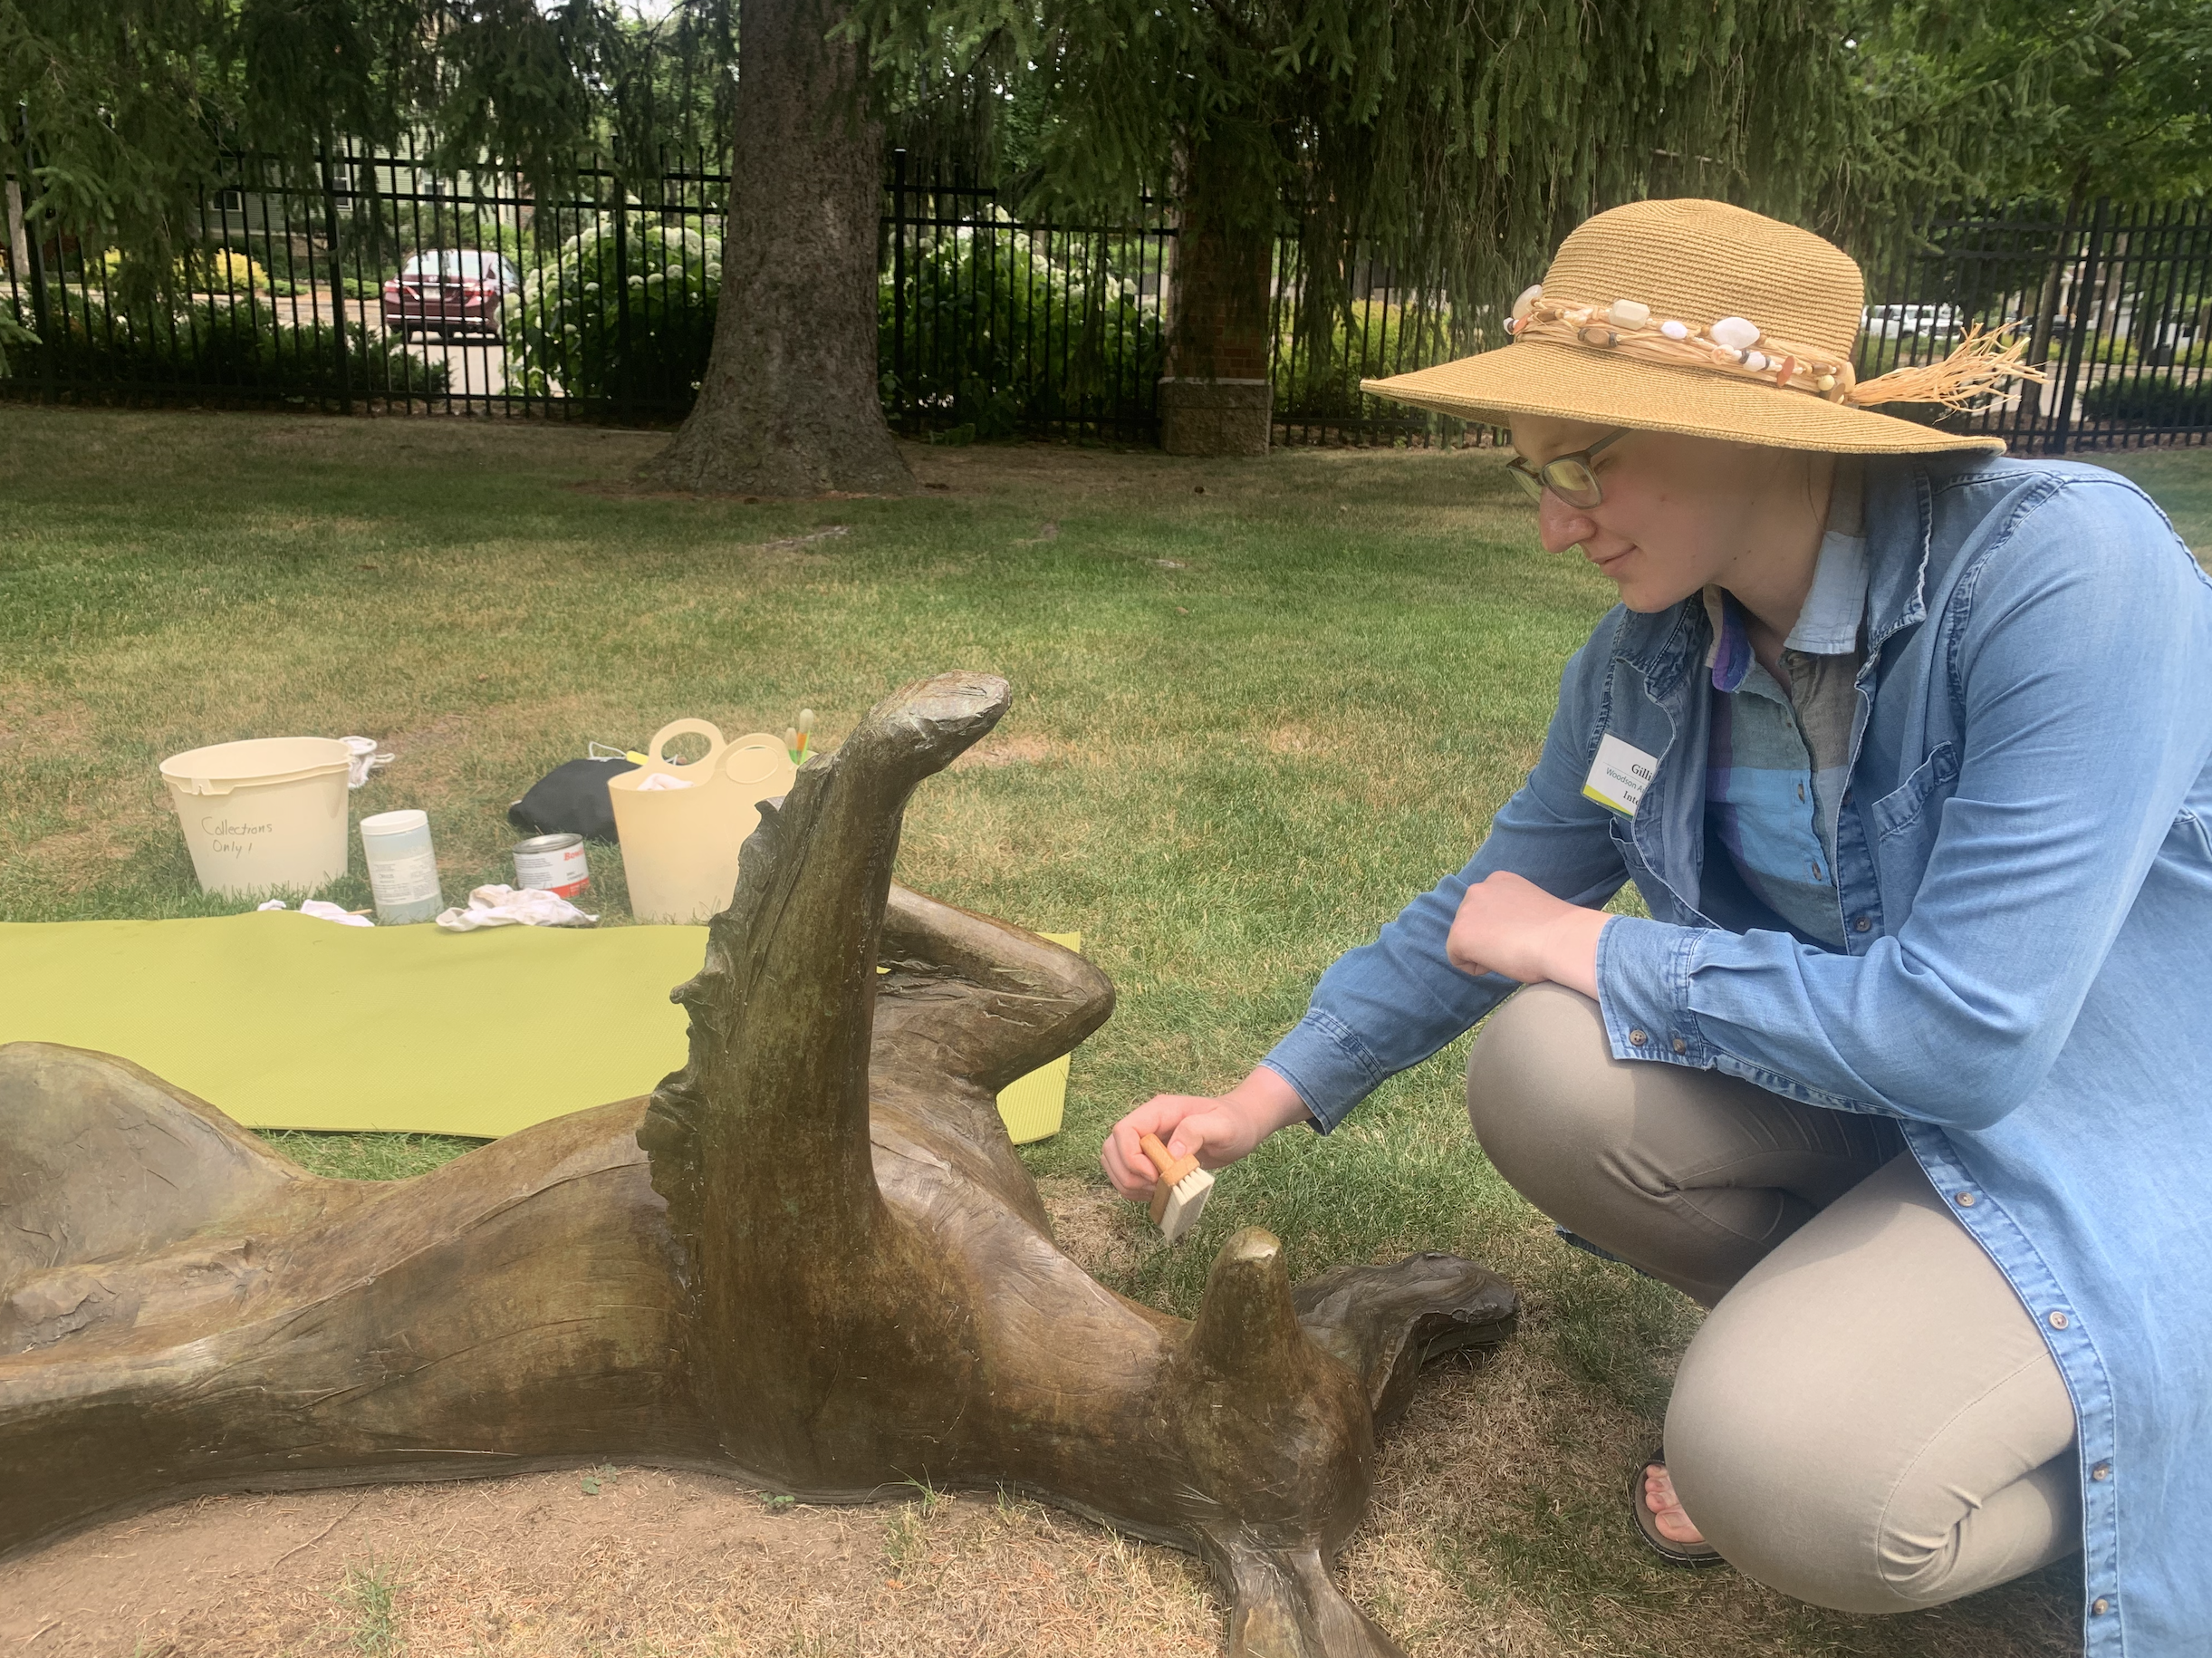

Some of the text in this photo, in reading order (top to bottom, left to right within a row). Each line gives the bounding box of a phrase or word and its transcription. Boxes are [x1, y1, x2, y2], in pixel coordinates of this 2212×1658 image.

[1606, 767, 1637, 789] Woodson
[1631, 764, 1653, 781] Gilli
[201, 815, 273, 835] Collections
